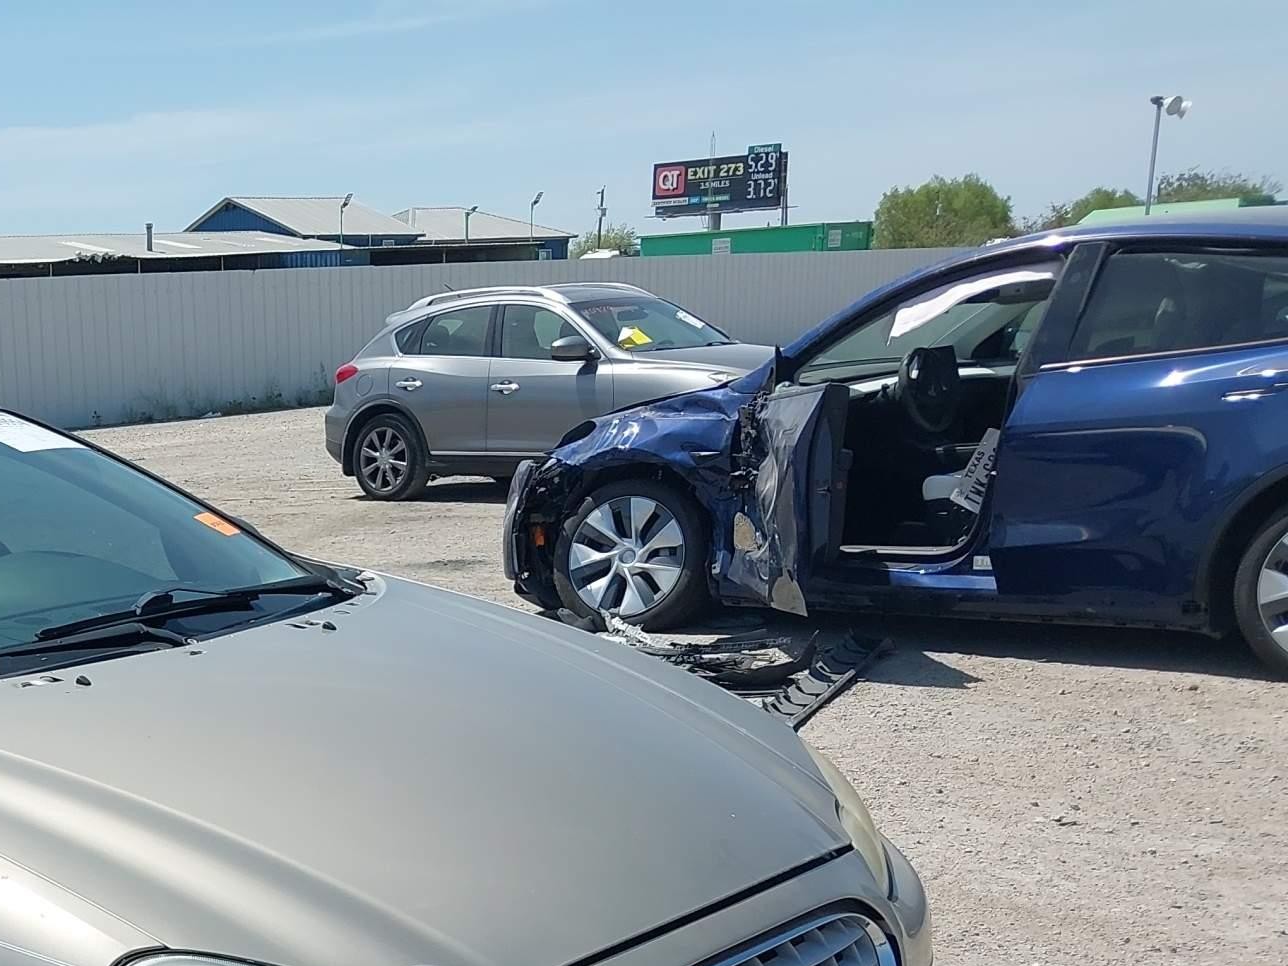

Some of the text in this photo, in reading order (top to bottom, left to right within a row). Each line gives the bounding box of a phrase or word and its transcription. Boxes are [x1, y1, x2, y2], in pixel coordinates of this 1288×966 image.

[754, 145, 774, 153] Diesel
[687, 162, 744, 180] EXIT 273
[751, 172, 773, 180] Unlead
[659, 170, 681, 190] QT
[711, 180, 730, 188] MILES
[964, 450, 985, 479] TEXAS
